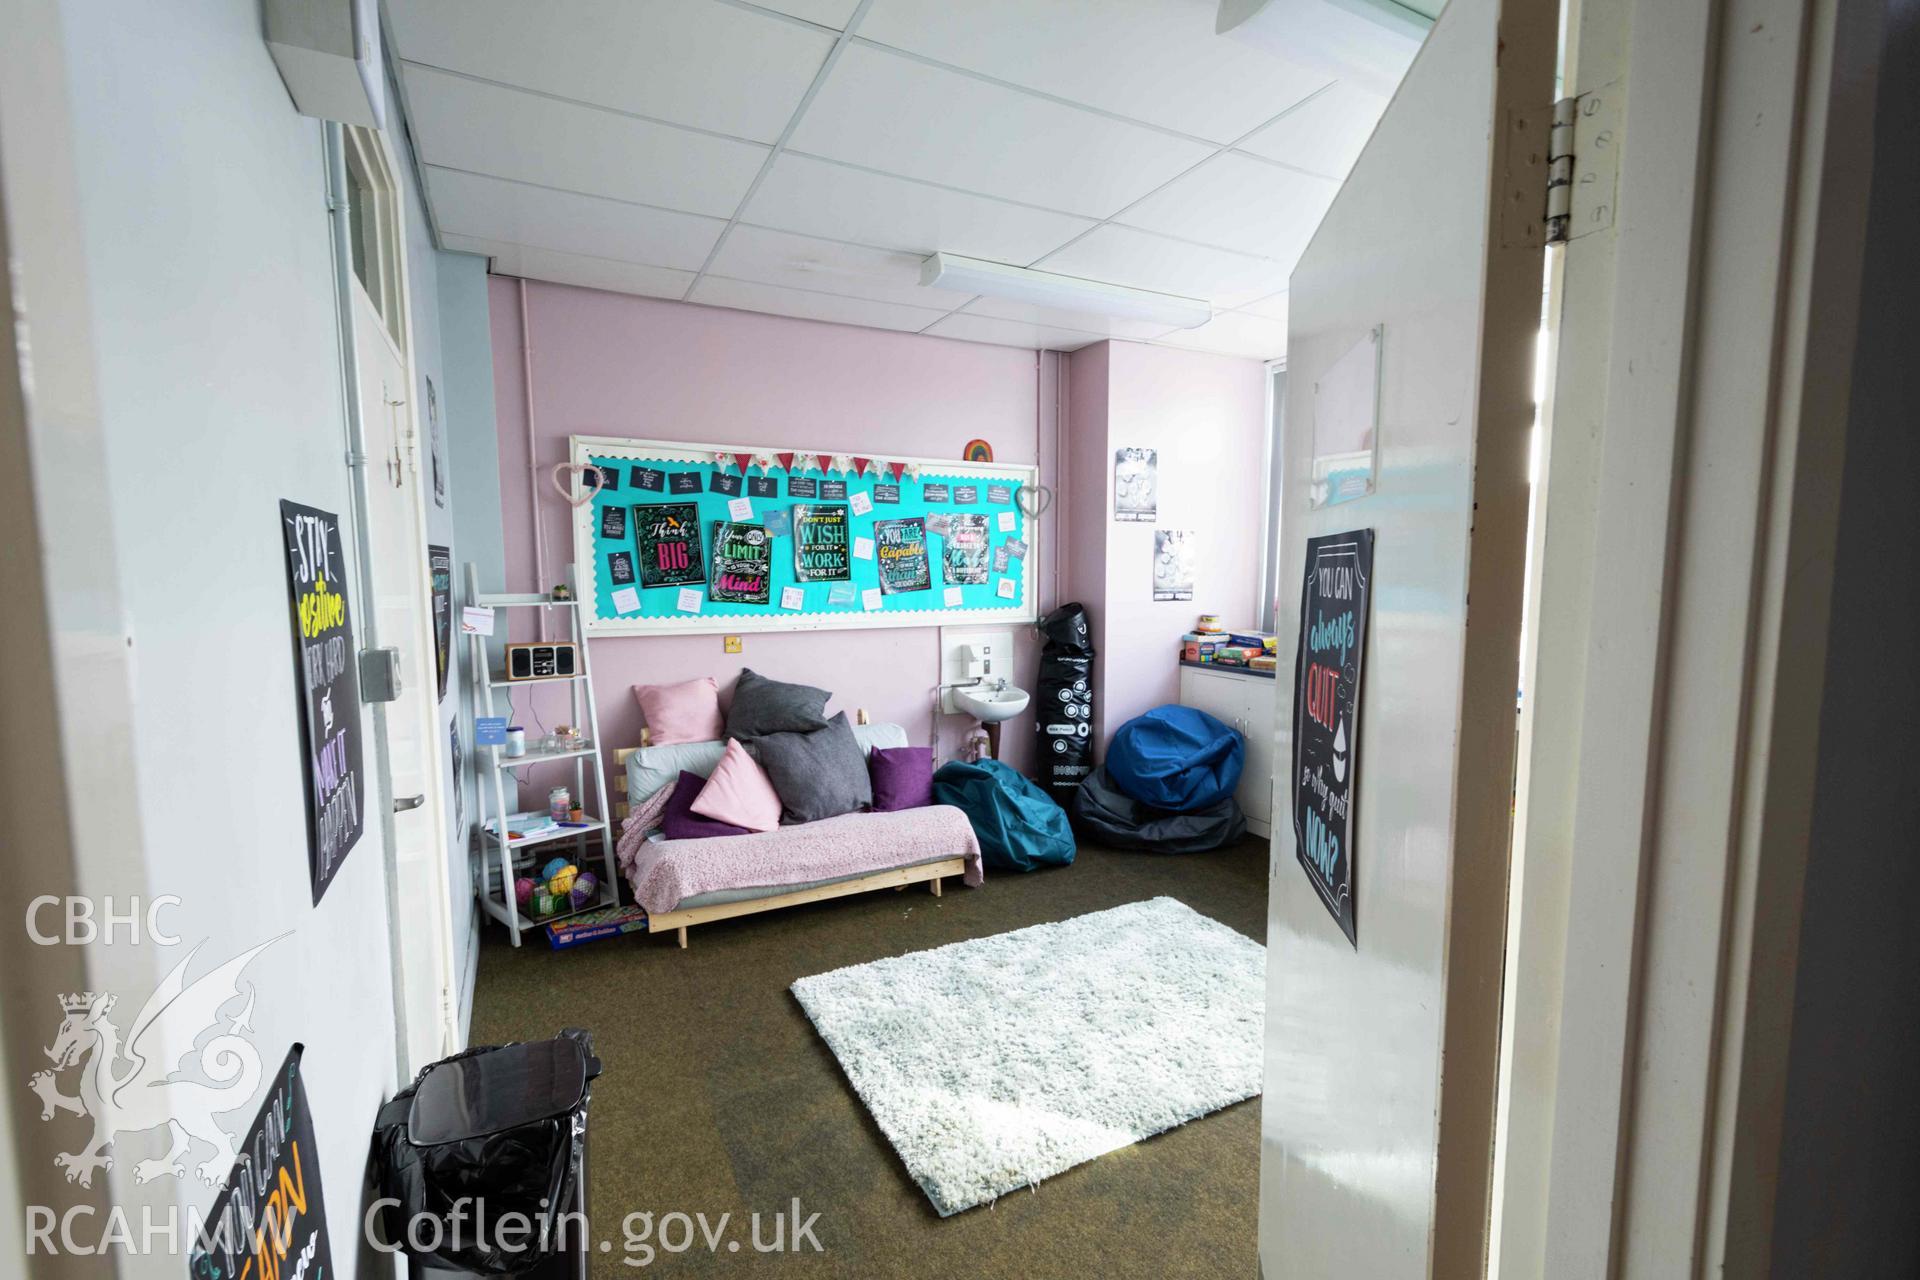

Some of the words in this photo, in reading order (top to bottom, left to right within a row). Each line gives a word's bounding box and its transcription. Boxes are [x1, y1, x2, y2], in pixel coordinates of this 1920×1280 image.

[650, 520, 689, 538] Think
[803, 516, 824, 524] DON'T
[824, 516, 842, 524] JUST
[799, 523, 846, 545] WISH
[296, 514, 330, 583] STAY
[657, 541, 690, 570] BIG
[724, 542, 761, 560] LIMIT
[802, 552, 844, 569] WORK
[719, 573, 762, 593] Mind
[809, 568, 827, 577] FOR
[827, 568, 837, 576] IT
[1319, 566, 1334, 598] YOU
[1335, 566, 1354, 601] CAN
[299, 571, 345, 638] ositive
[1311, 608, 1355, 668] always
[1307, 662, 1341, 733] QUIT
[1306, 804, 1339, 888] NOW?
